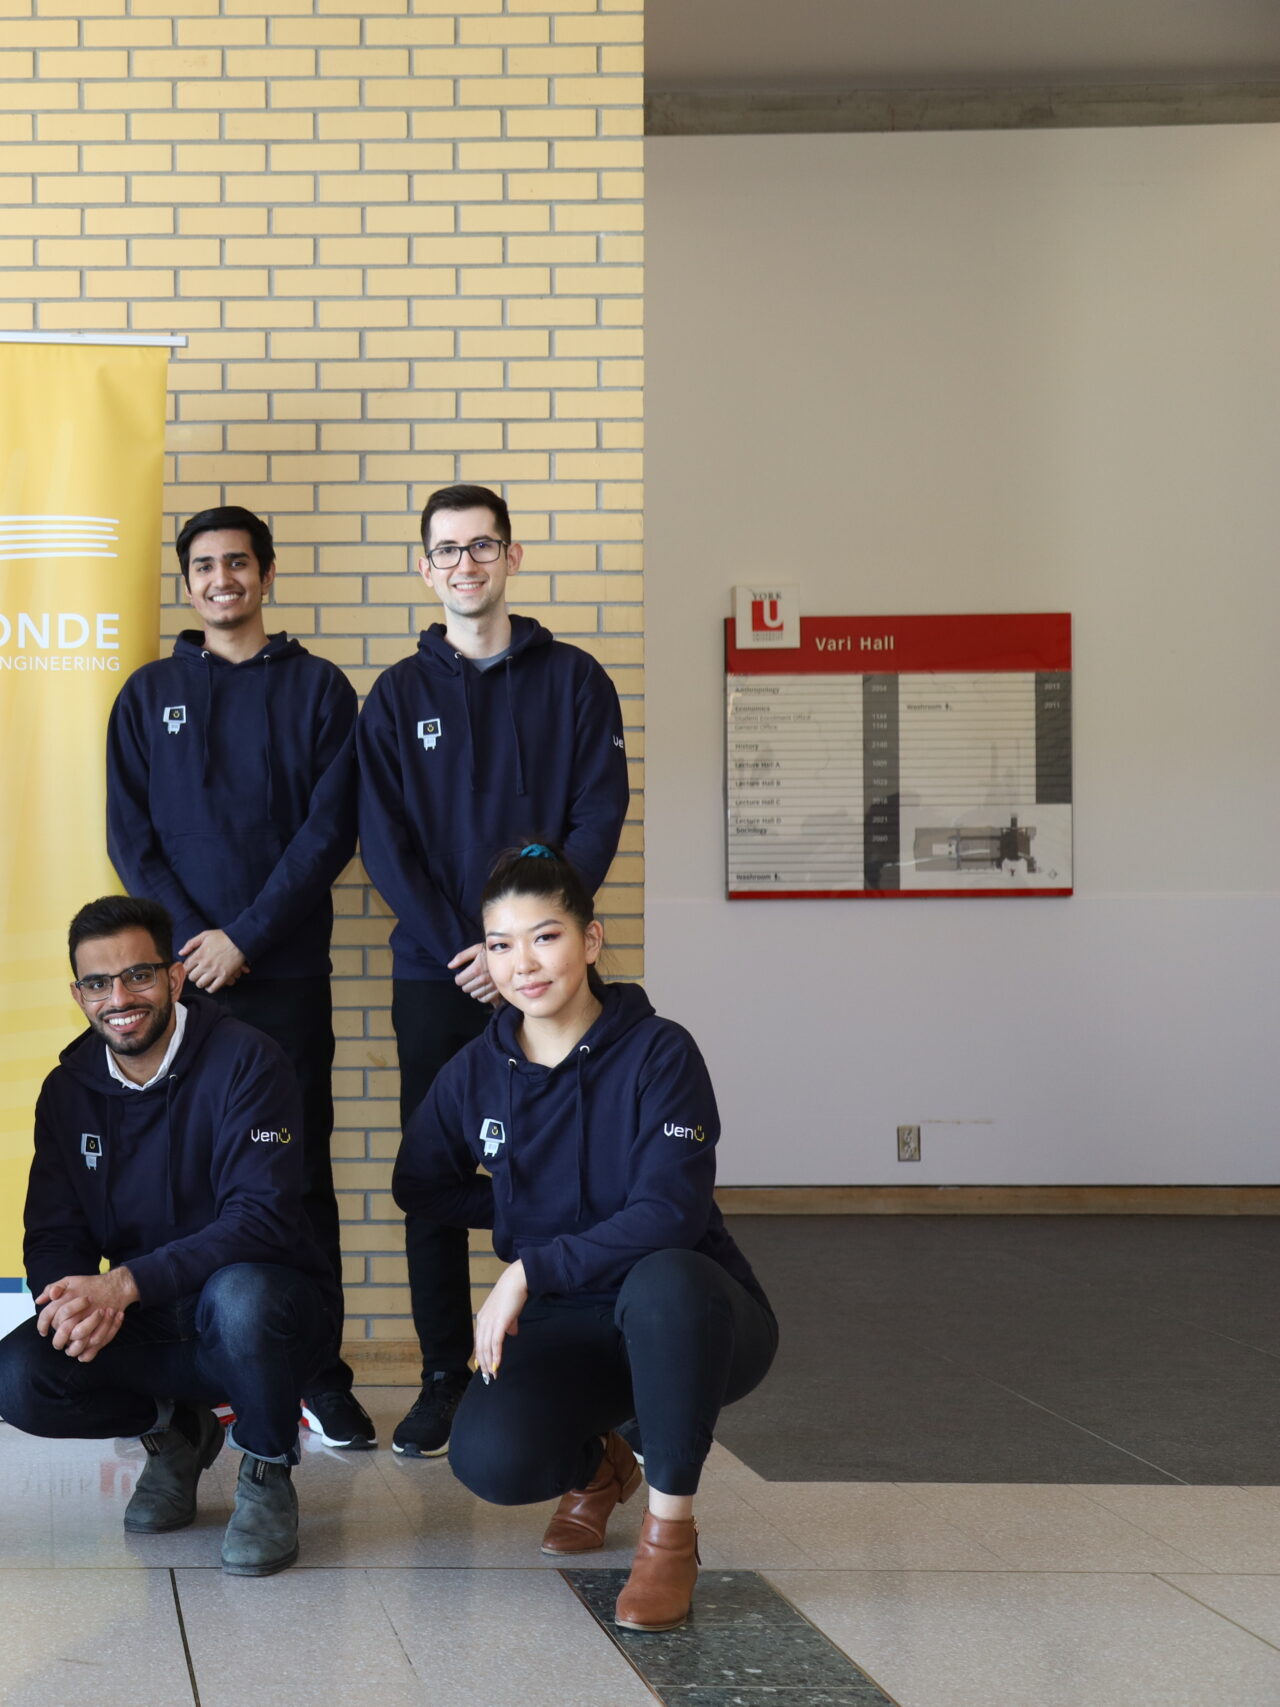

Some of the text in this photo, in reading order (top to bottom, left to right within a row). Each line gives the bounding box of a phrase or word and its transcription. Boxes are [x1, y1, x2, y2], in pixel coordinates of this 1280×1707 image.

[815, 635, 894, 651] Vari Hall
[612, 735, 624, 748] Ve
